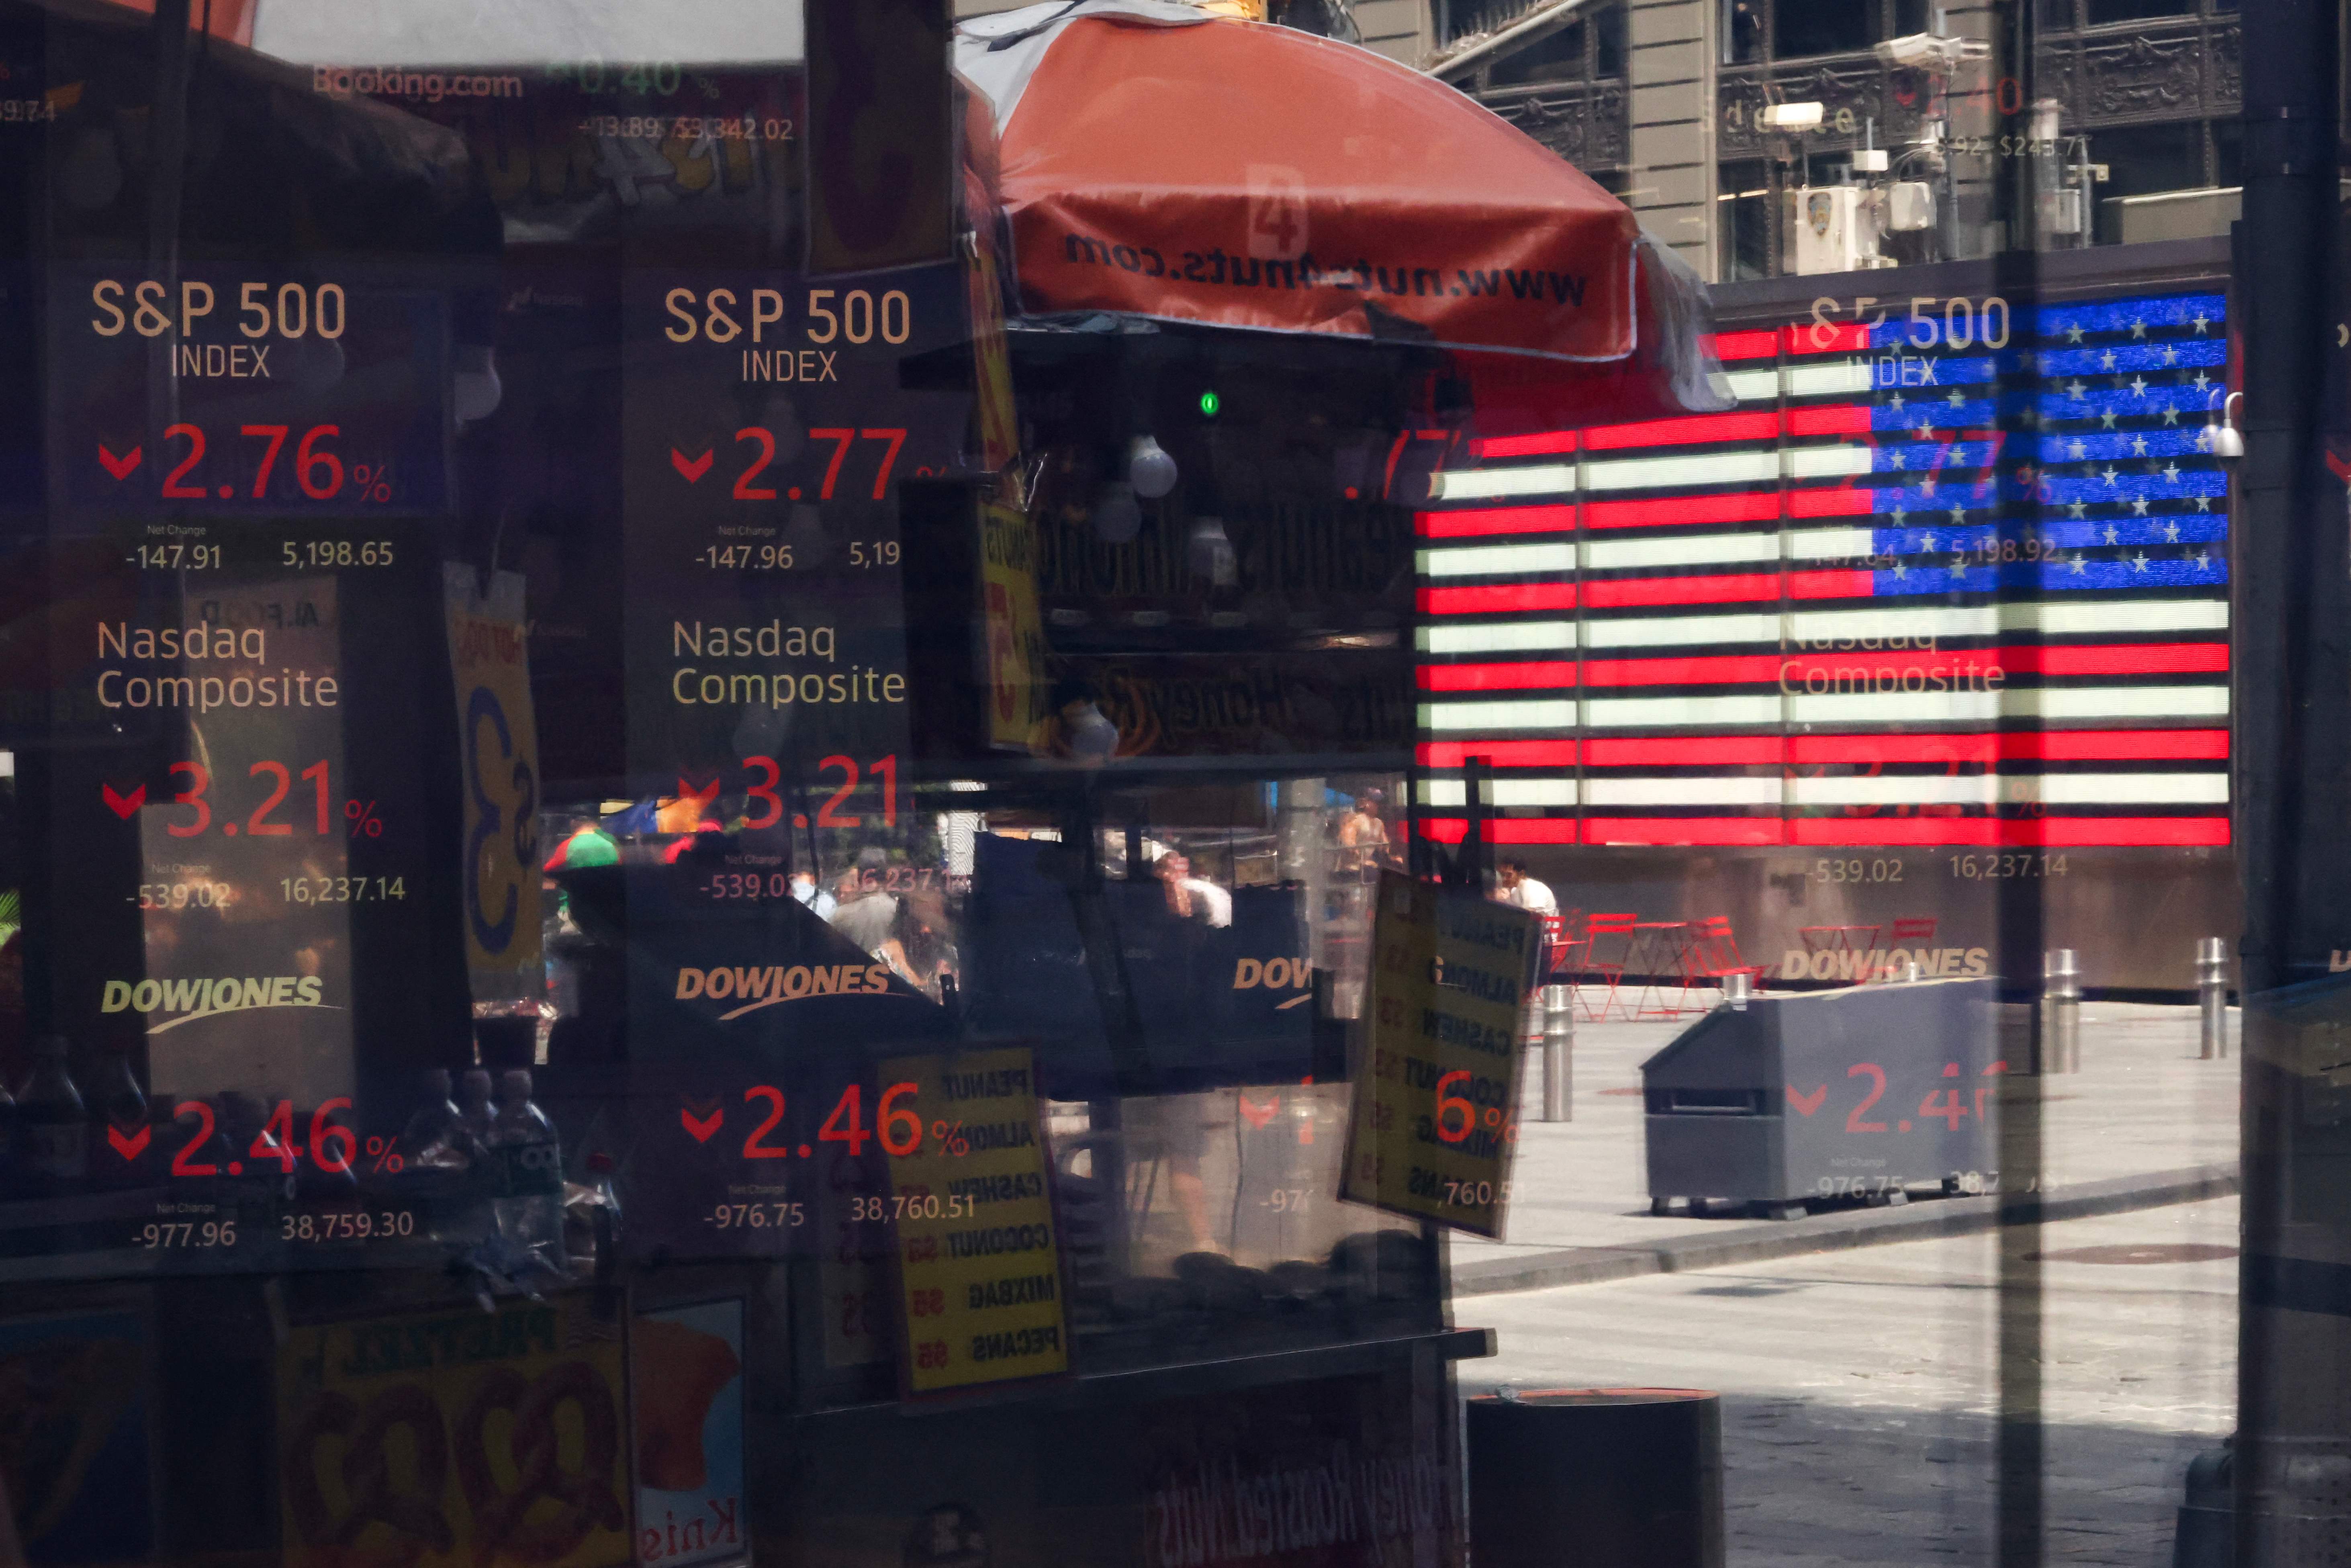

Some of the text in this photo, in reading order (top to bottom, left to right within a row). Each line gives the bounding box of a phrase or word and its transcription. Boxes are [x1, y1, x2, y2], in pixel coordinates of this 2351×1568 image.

[313, 65, 523, 102] Booking.com
[92, 279, 345, 339] S&P 500
[665, 287, 910, 345] S&P 500
[1784, 296, 2010, 350] &P 500
[172, 344, 270, 378] INDEX
[742, 350, 838, 382] INDEX
[732, 427, 947, 500] 2.77
[167, 524, 206, 537] Change
[125, 541, 394, 569] -147.91 5,198.65
[695, 545, 794, 569] -147.96
[98, 621, 265, 665] Nasdaq
[673, 618, 836, 662] Nasdaq
[97, 667, 339, 714] Composite
[673, 665, 906, 710] Composite
[1779, 657, 2006, 697] Composite
[741, 754, 897, 830] 3.21
[1806, 854, 2069, 883] -539.02 16,237.14
[125, 876, 406, 910] -539.02 16,237.14
[131, 1211, 414, 1249] -977.96 38,759.30
[703, 1195, 975, 1229] -976.75 38,760.51
